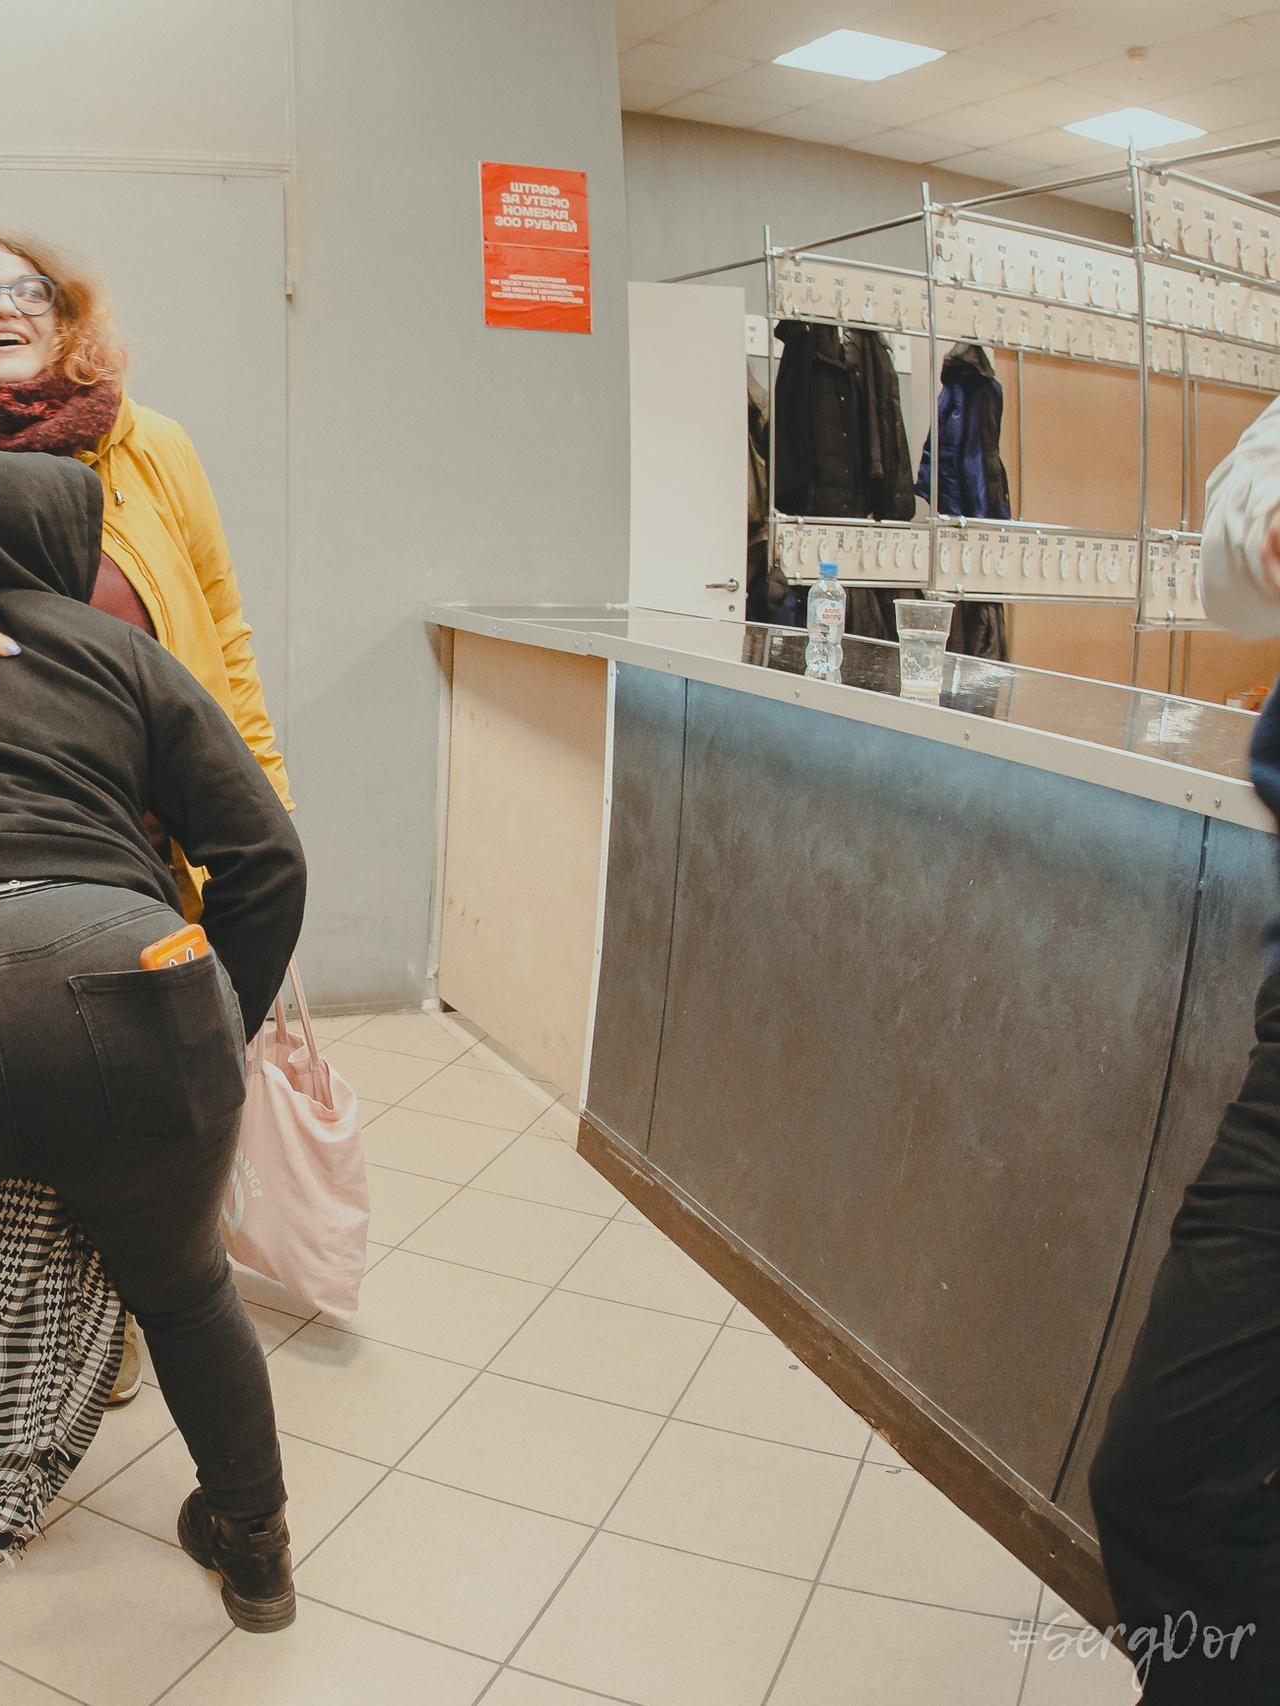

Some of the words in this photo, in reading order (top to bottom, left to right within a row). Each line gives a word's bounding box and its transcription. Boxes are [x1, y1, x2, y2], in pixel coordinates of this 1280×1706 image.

[510, 182, 560, 196] ШТРАФ
[501, 193, 520, 204] ЗА
[523, 194, 570, 209] УТЕРЮ
[503, 204, 569, 220] НОМЕРКА
[494, 215, 522, 228] 300
[524, 217, 578, 233] РУБЛЕЙ
[822, 613, 842, 621] spring
